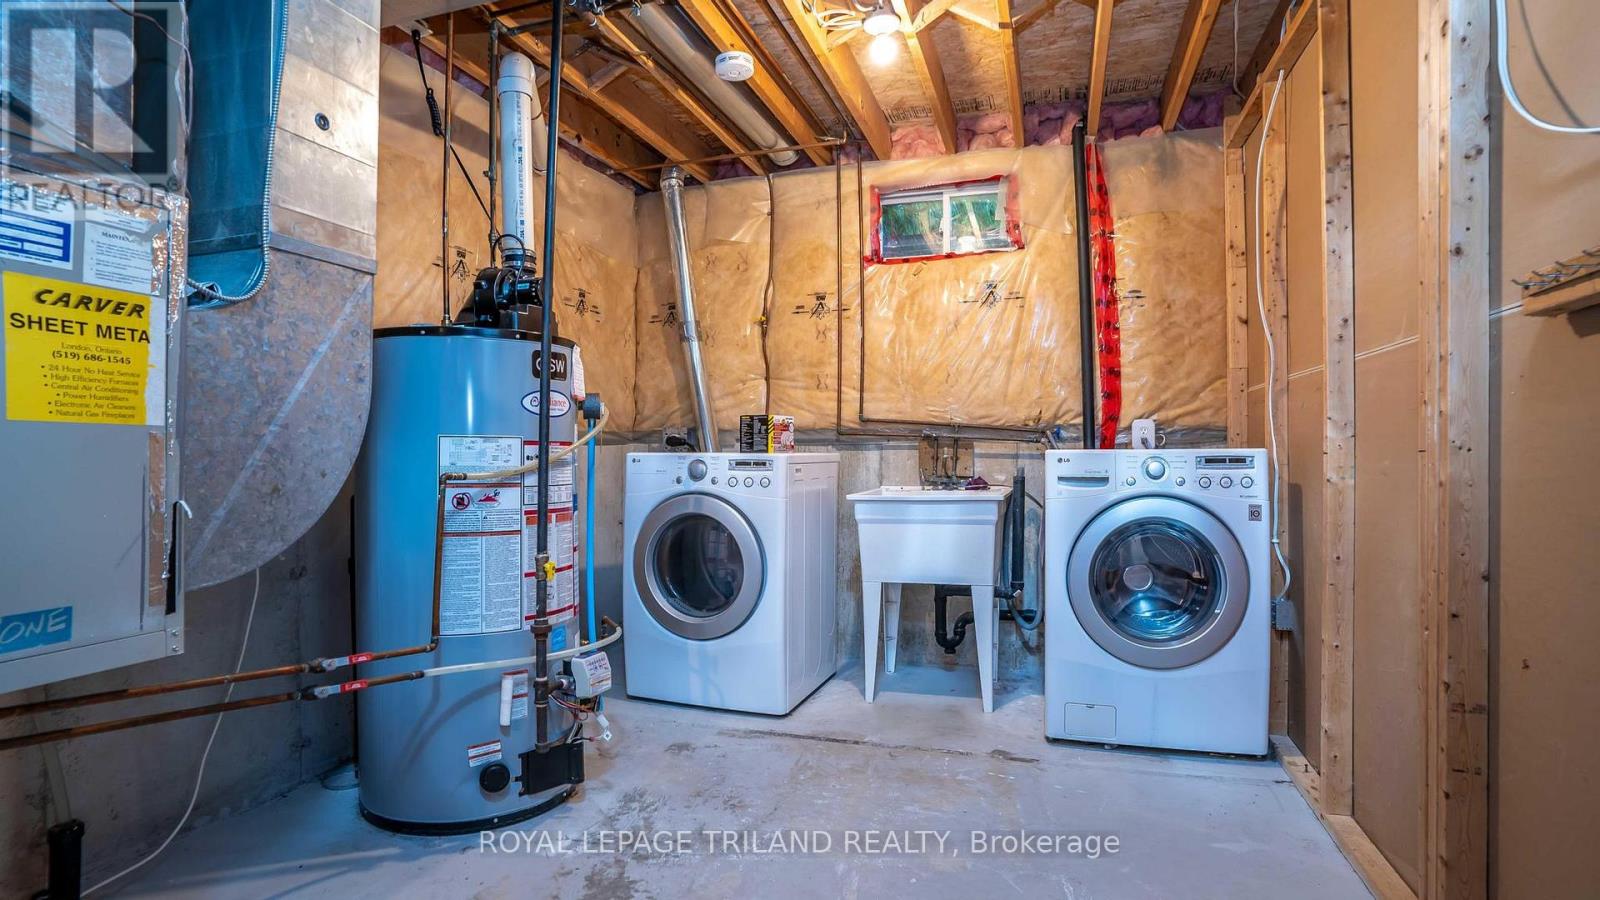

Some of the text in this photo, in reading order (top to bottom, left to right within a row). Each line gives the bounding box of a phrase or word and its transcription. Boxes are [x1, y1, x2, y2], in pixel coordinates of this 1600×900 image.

[34, 289, 146, 319] CARVER
[10, 312, 88, 336] SHEET
[61, 341, 92, 352] London,
[52, 350, 131, 365] (519) 686-1545
